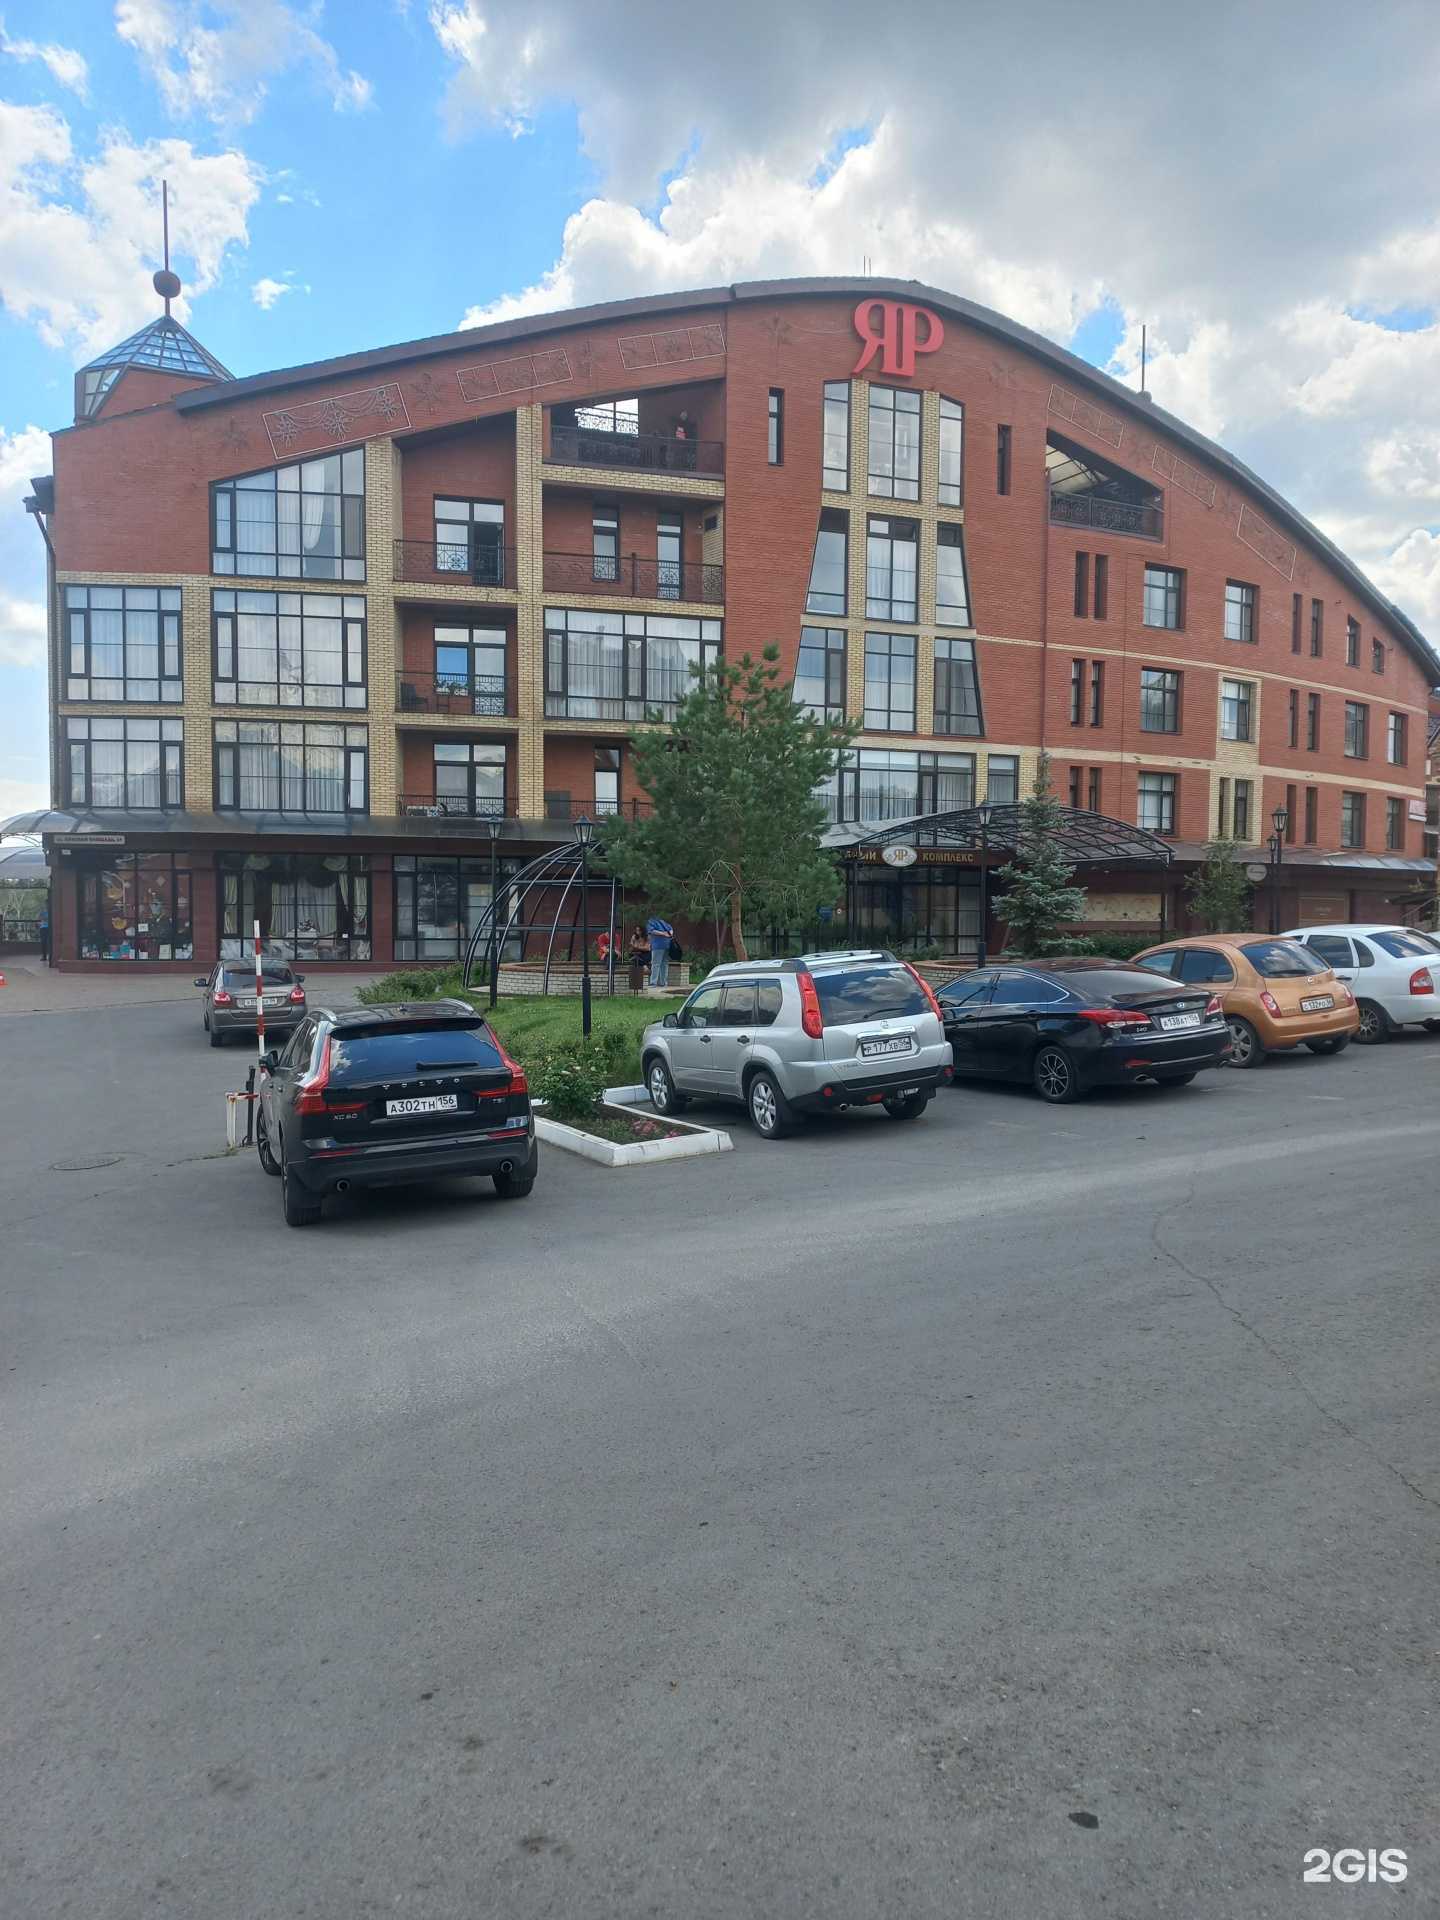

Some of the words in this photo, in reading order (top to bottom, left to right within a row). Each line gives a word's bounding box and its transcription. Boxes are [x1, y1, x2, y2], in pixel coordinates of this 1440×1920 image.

[850, 298, 944, 376] ЯР
[922, 852, 974, 862] КОМПЛЕКС
[390, 1099, 436, 1114] А302ТН
[438, 1095, 454, 1106] 156
